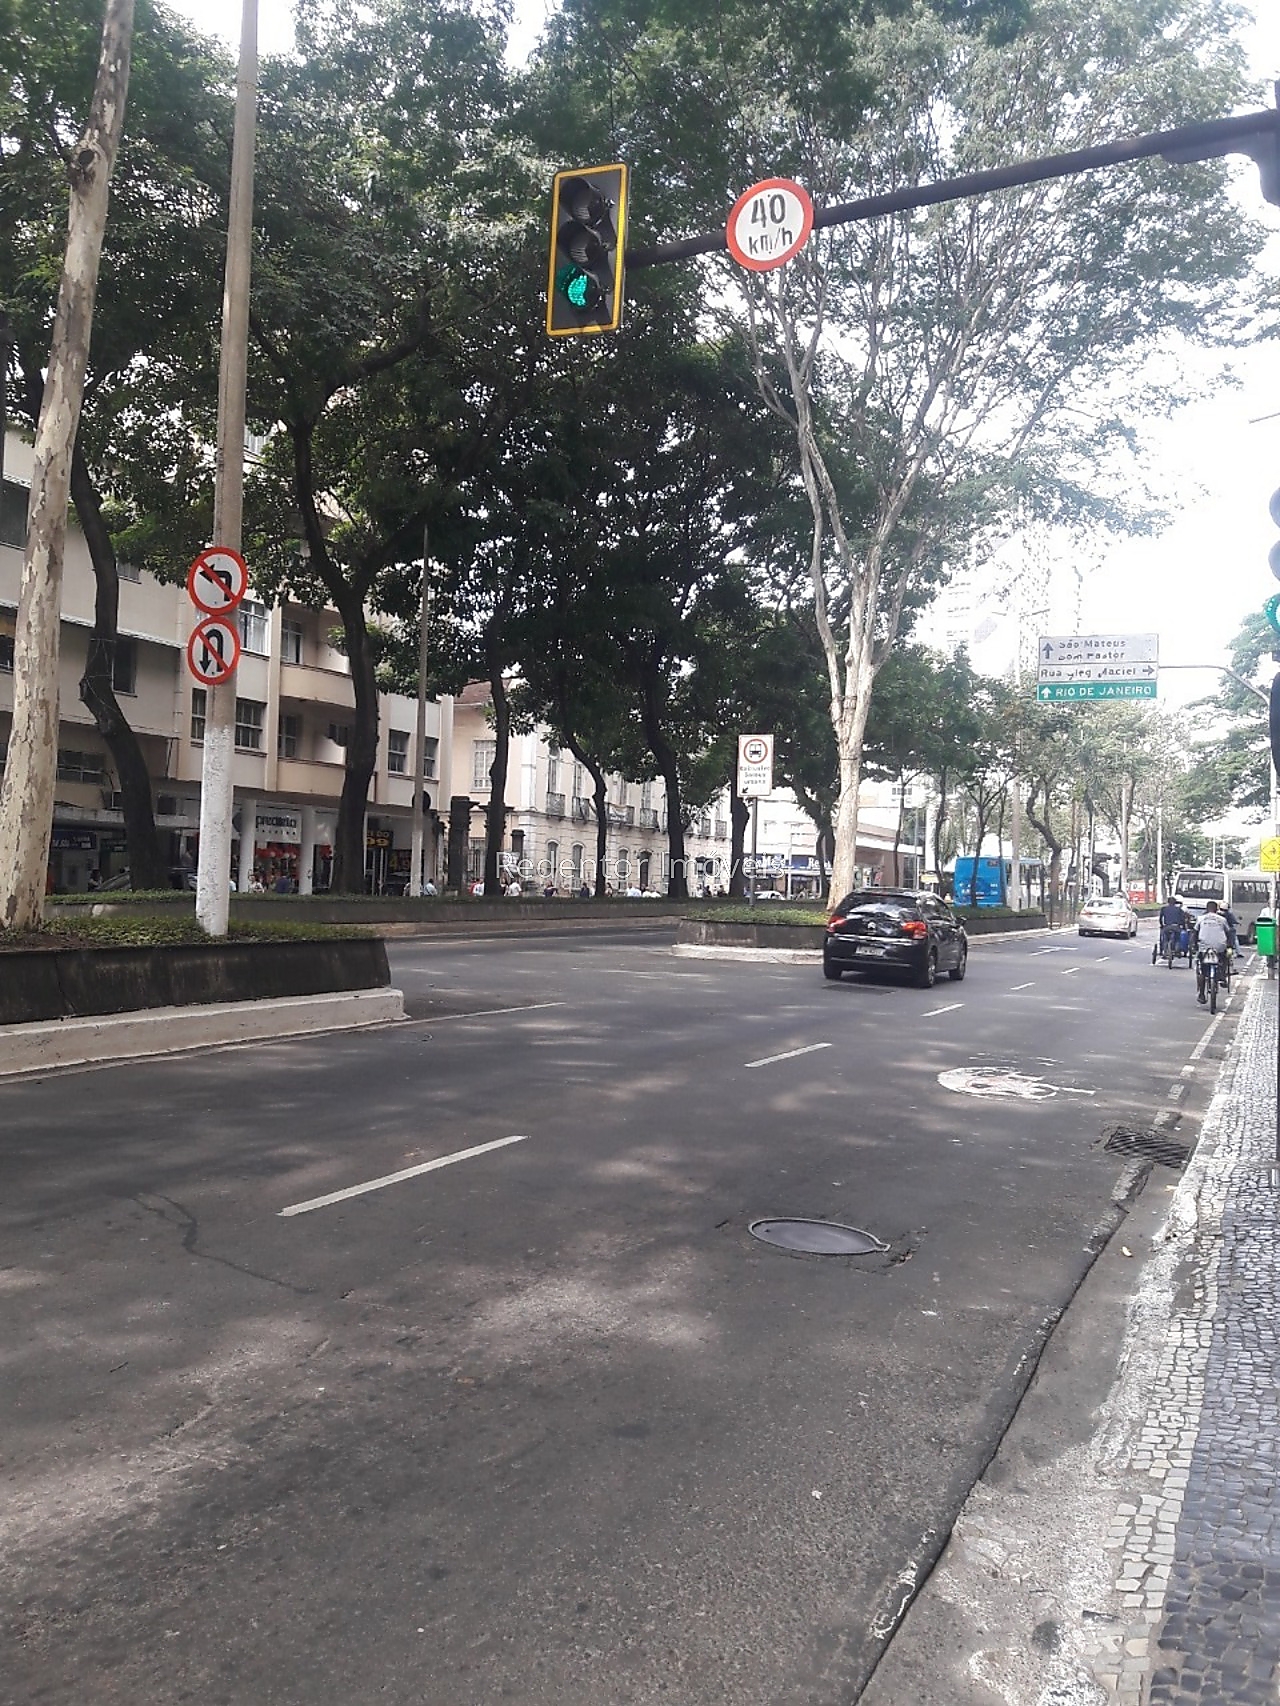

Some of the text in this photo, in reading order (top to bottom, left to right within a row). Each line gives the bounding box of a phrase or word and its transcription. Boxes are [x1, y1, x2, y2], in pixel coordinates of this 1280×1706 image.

[751, 194, 786, 228] 40
[748, 227, 793, 255] km/h
[1083, 639, 1127, 648] Mateus
[1040, 668, 1062, 678] Rua
[1055, 685, 1152, 697] RIO DE JANEIRO
